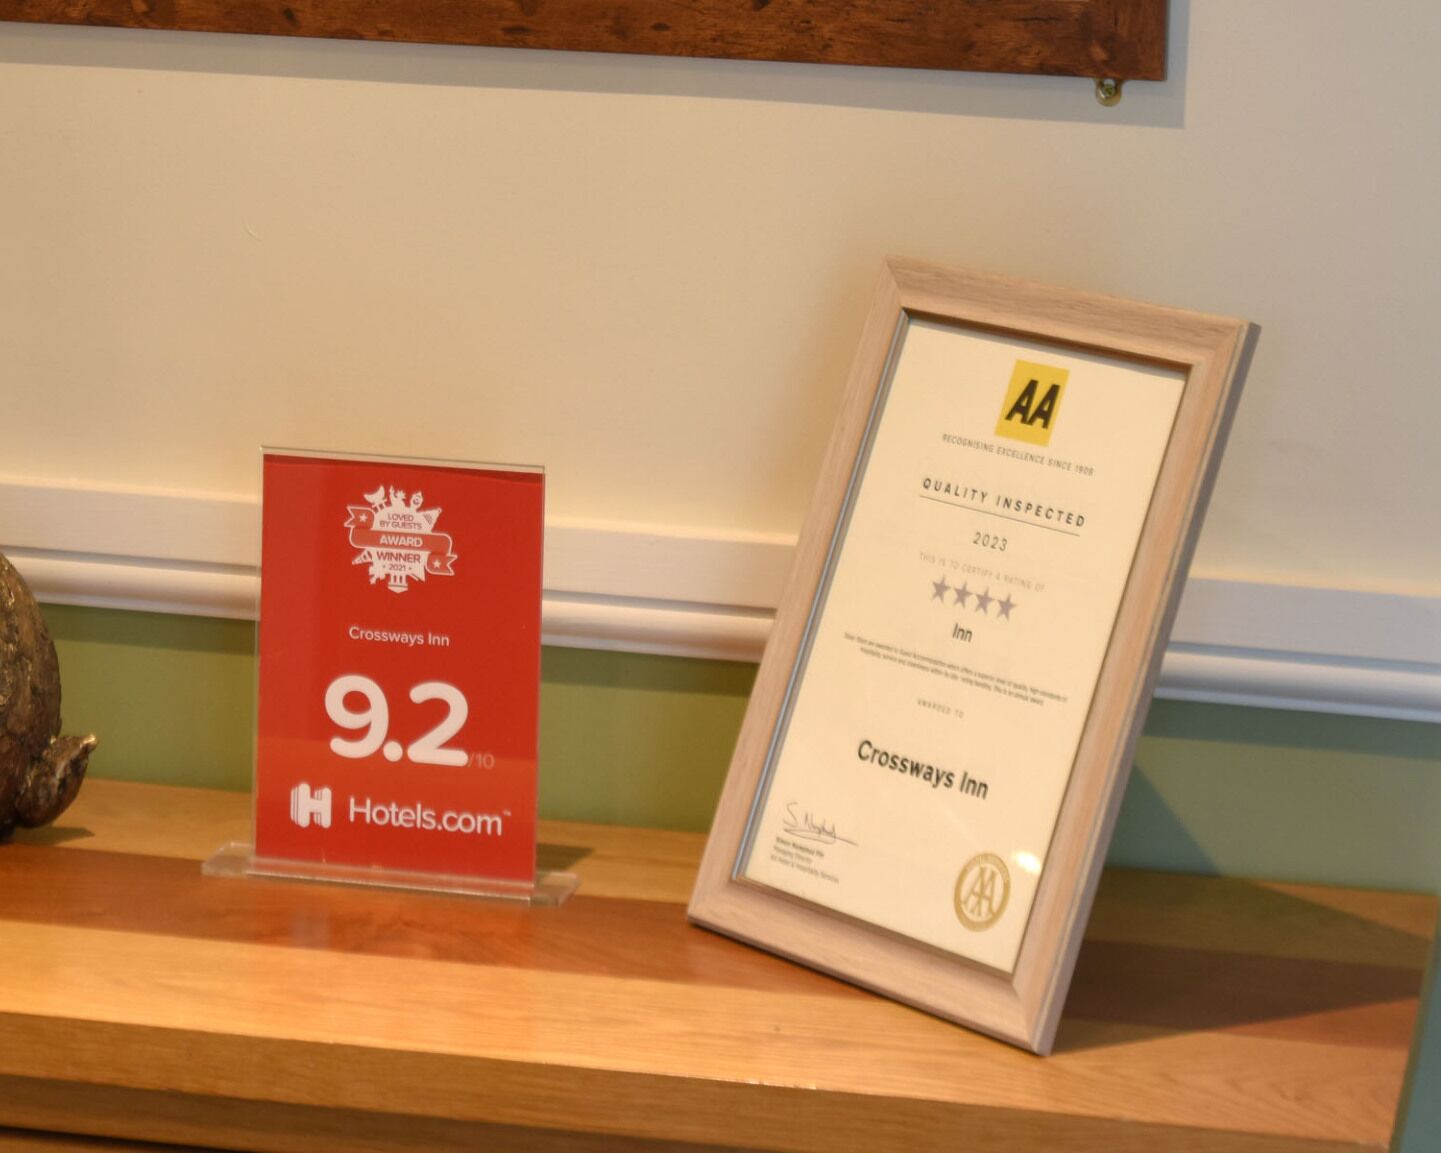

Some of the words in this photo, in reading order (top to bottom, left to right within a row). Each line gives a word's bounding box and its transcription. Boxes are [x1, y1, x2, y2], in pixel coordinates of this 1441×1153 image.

[1005, 379, 1061, 429] AA
[942, 433, 995, 453] RECOGNISING
[996, 447, 1045, 465] EXCELLENCE
[1047, 458, 1072, 472] SINCE
[923, 477, 988, 503] QUALITY
[996, 495, 1086, 528] INSPECTED
[380, 520, 389, 528] BY
[391, 521, 422, 530] GUESTS
[388, 513, 414, 522] LOVED
[380, 534, 423, 548] AWARD
[972, 531, 1009, 552] 2023
[376, 551, 421, 564] WINNER
[388, 563, 408, 572] 2021
[348, 626, 425, 647] Crossways
[428, 632, 450, 647] Inn
[951, 622, 973, 643] Inn
[325, 674, 469, 767] 9.2
[857, 739, 955, 789] Crossways
[959, 770, 989, 800] Inn
[349, 796, 503, 837] Hotels.com
